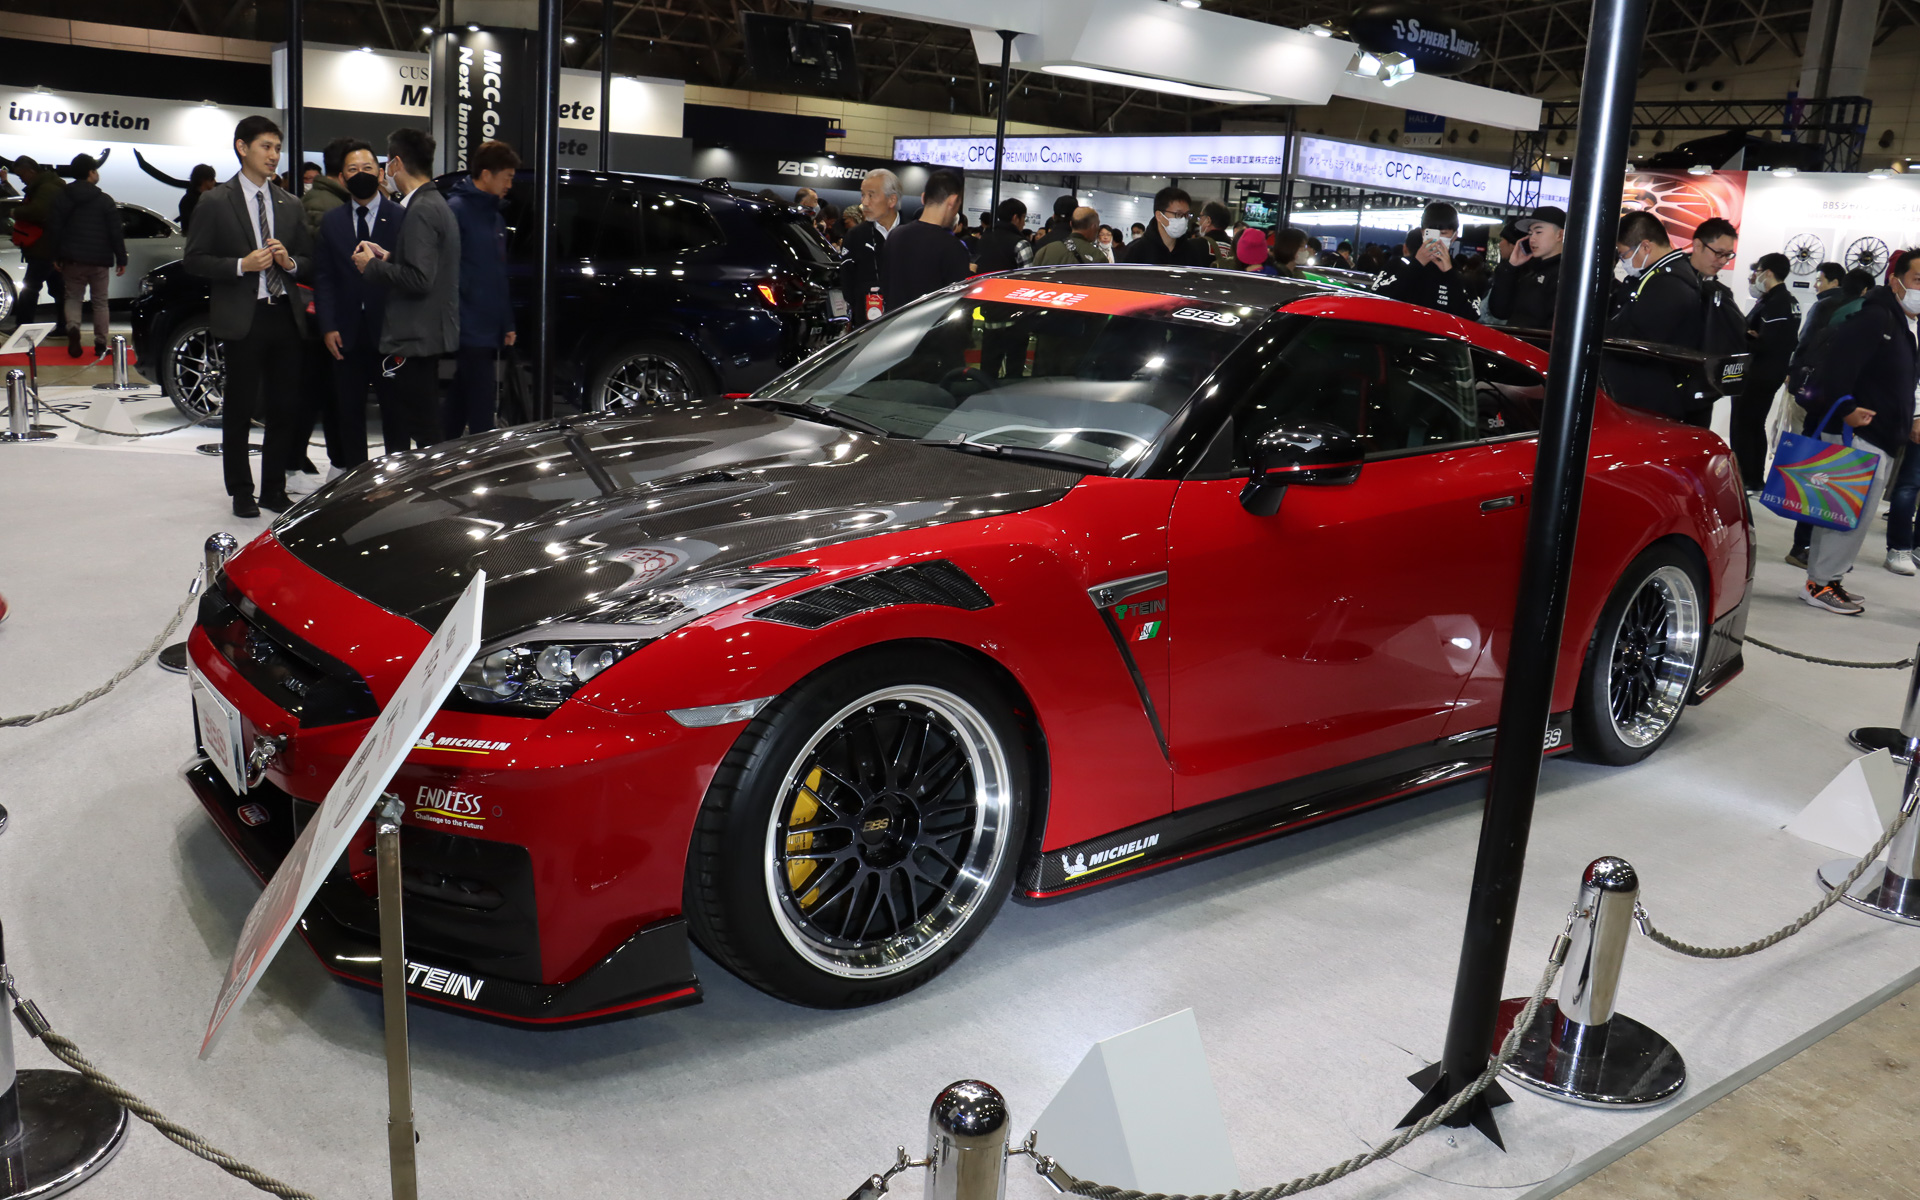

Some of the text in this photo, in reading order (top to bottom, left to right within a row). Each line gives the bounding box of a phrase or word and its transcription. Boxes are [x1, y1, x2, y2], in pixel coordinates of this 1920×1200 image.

[1407, 19, 1474, 57] SPHERE LIGHT
[399, 65, 429, 80] CUS
[400, 85, 428, 107] M
[9, 101, 151, 131] innovation
[457, 46, 473, 172] Next innova
[559, 101, 595, 121] ete
[1408, 114, 1428, 123] HALL
[558, 139, 588, 156] ete
[968, 145, 995, 163] CPC
[1040, 145, 1083, 163] COATING
[820, 165, 868, 180] FORGED
[1385, 161, 1412, 180] CPC
[1415, 166, 1450, 186] PREMIUM
[1452, 171, 1487, 191] COATING
[1172, 307, 1241, 327] BBS
[1723, 363, 1745, 377] ENDLESS
[1763, 493, 1857, 526] BEYOND AUTOBACS
[1128, 598, 1167, 617] TEIN
[435, 736, 512, 752] MICHELIN
[1543, 728, 1562, 749] BS
[415, 785, 484, 815] ENDLESS
[415, 811, 484, 831] Challenge to the Future
[862, 817, 890, 833] BBS
[1089, 833, 1160, 867] MICHELIN
[406, 961, 485, 1001] TEIN
